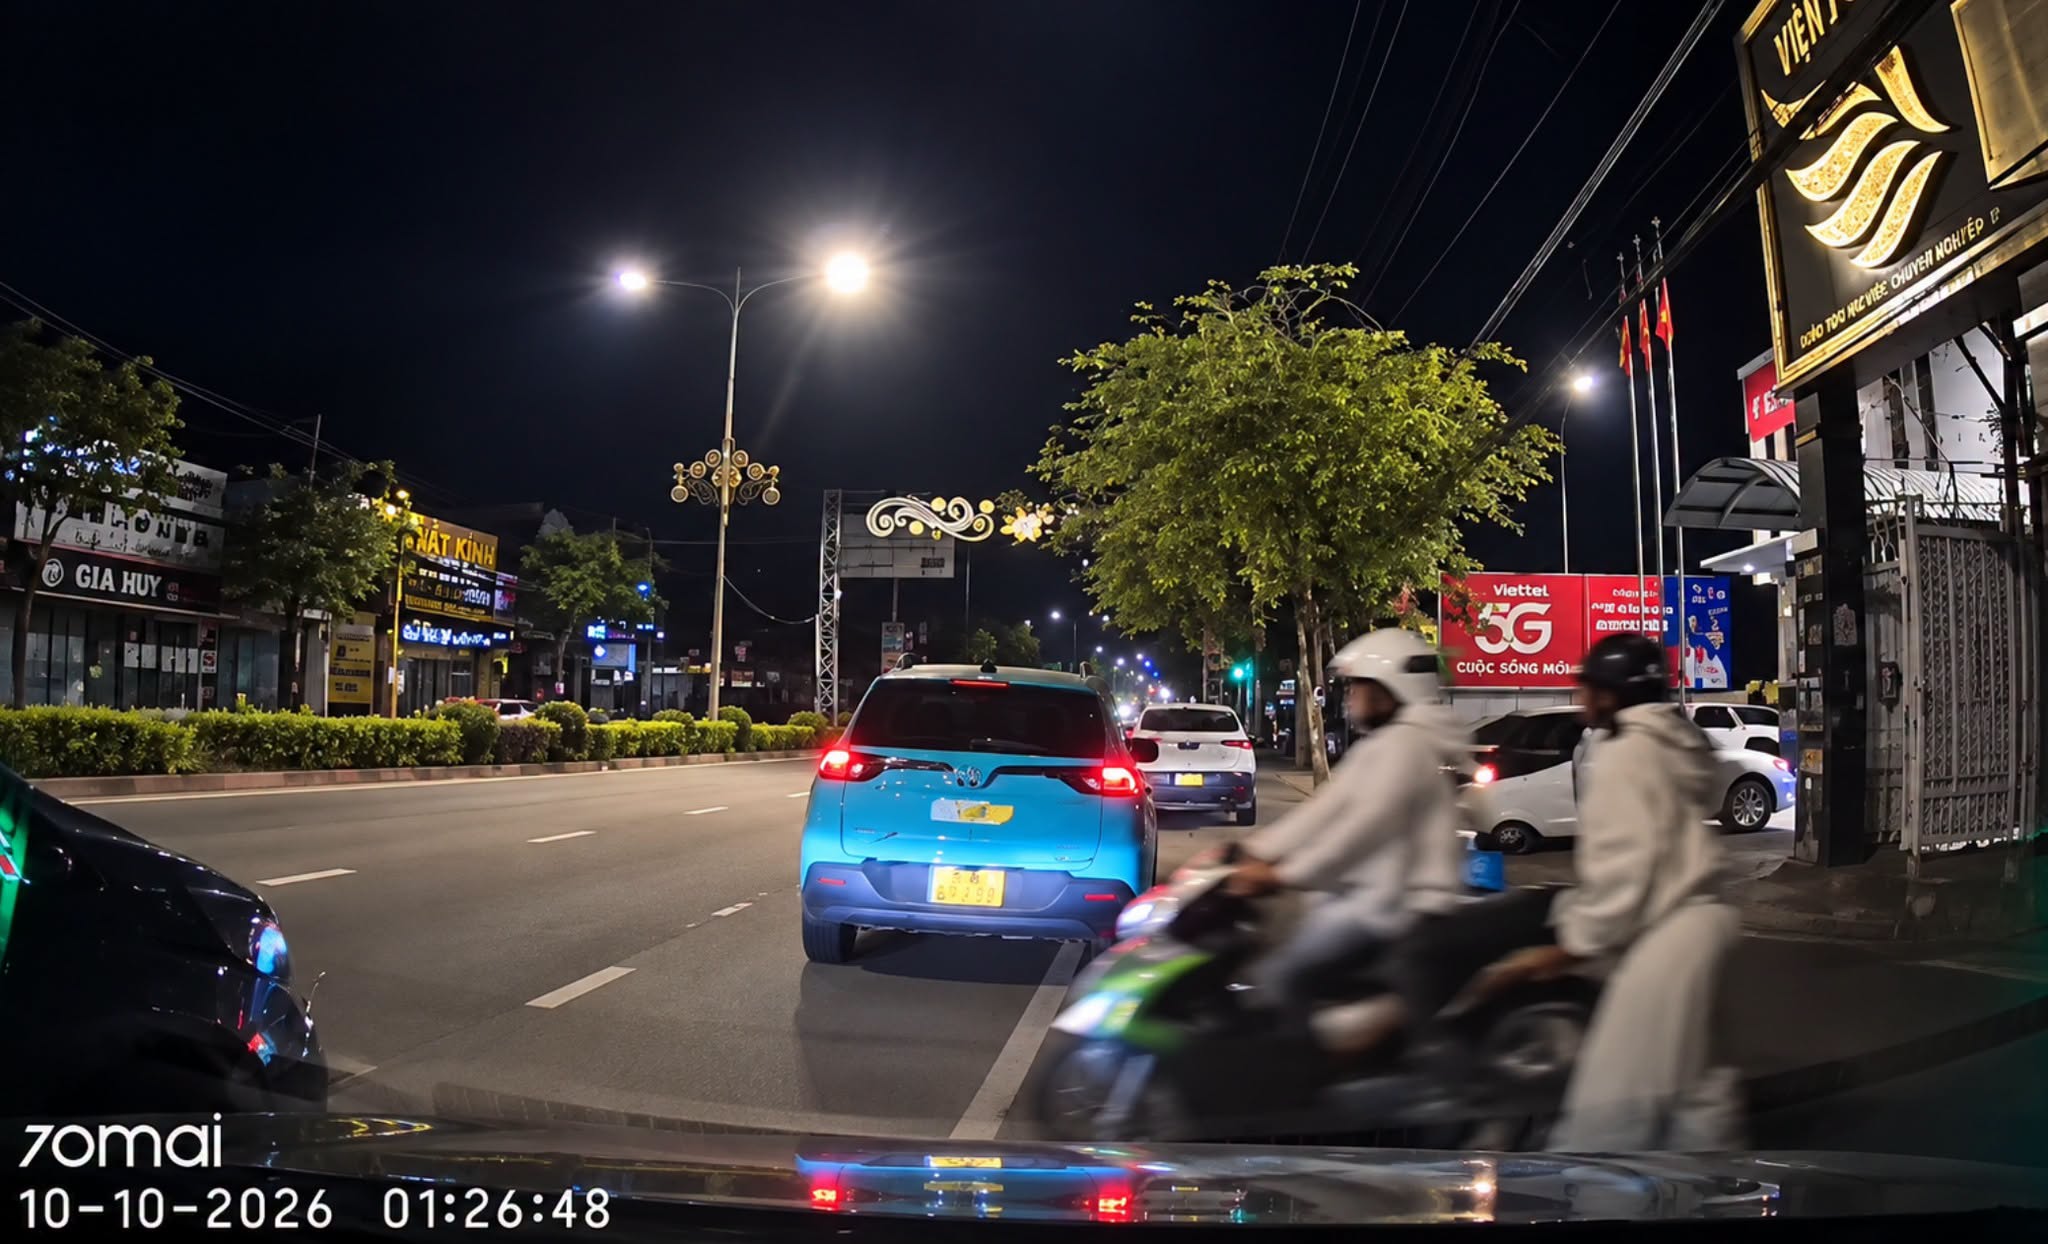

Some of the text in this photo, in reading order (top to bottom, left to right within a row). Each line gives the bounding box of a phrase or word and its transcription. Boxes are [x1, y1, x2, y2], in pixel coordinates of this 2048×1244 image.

[455, 532, 497, 566] KÍNH
[75, 563, 115, 592] GIA
[121, 570, 162, 597] HUY
[1474, 602, 1553, 655] 5G
